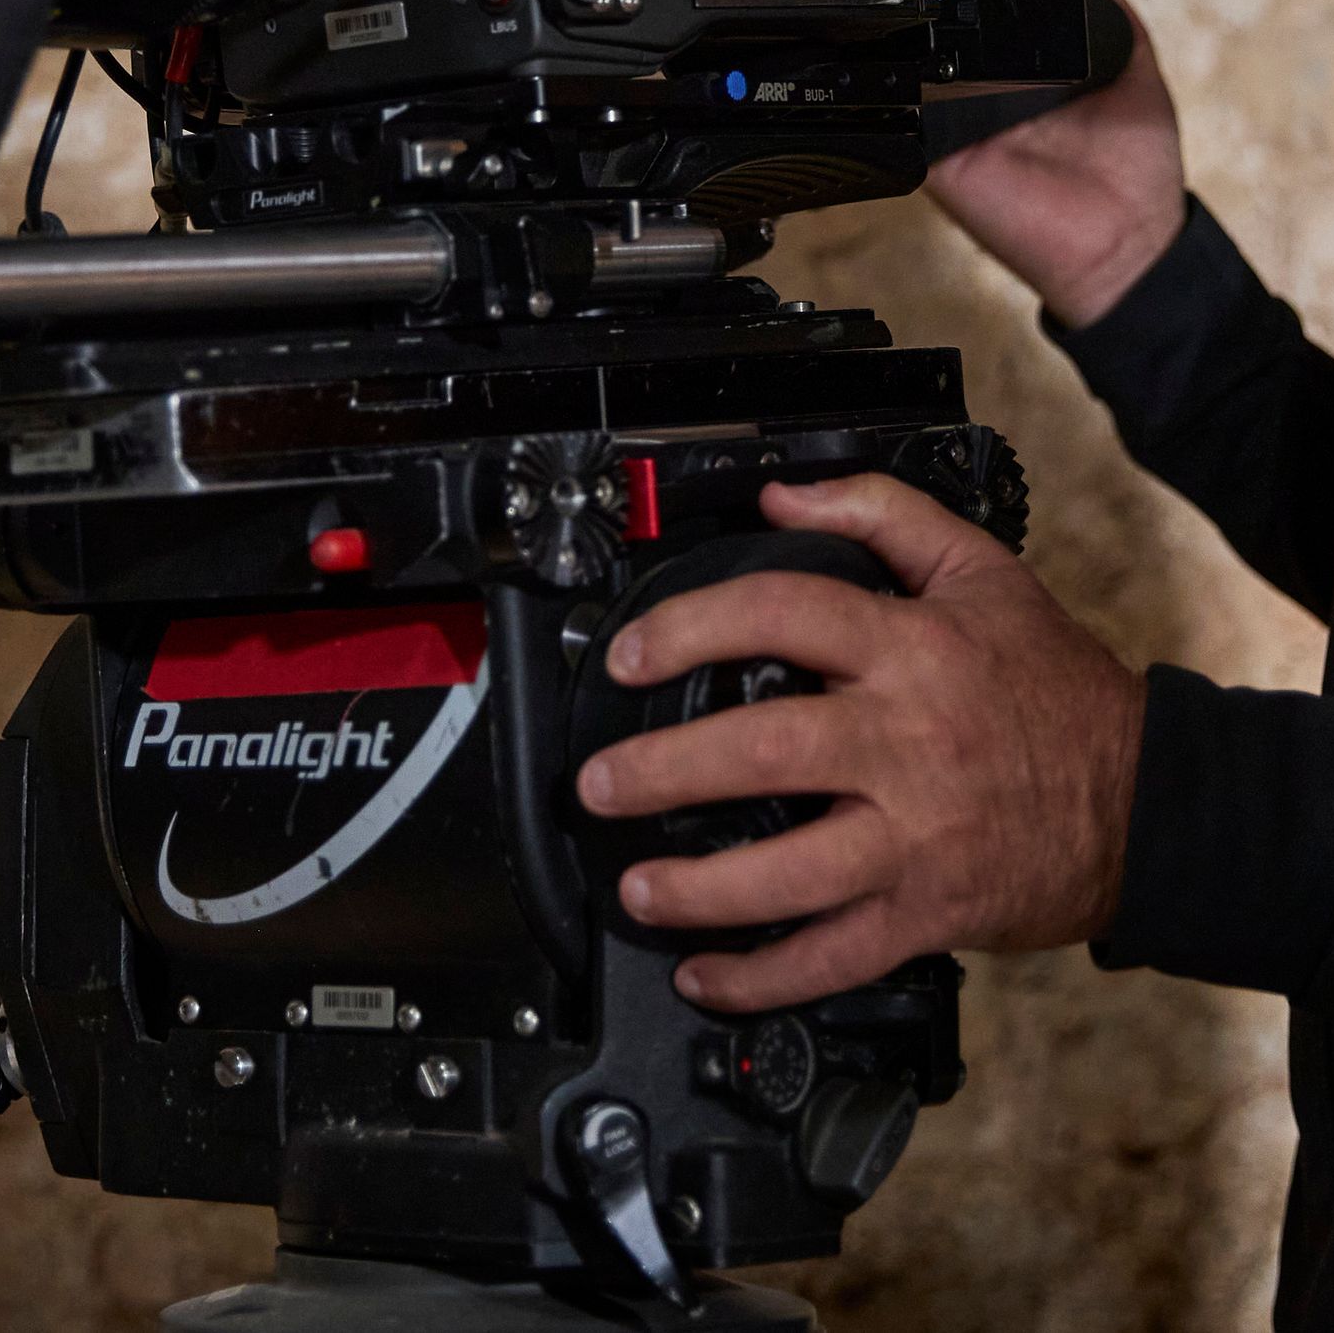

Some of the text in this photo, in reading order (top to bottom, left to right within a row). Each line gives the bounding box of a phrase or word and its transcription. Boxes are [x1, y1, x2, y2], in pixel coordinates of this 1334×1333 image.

[490, 19, 518, 34] LBUS
[753, 82, 835, 102] ARRI BUD-1
[250, 188, 315, 209] Panalight
[124, 701, 394, 780] Panalight
